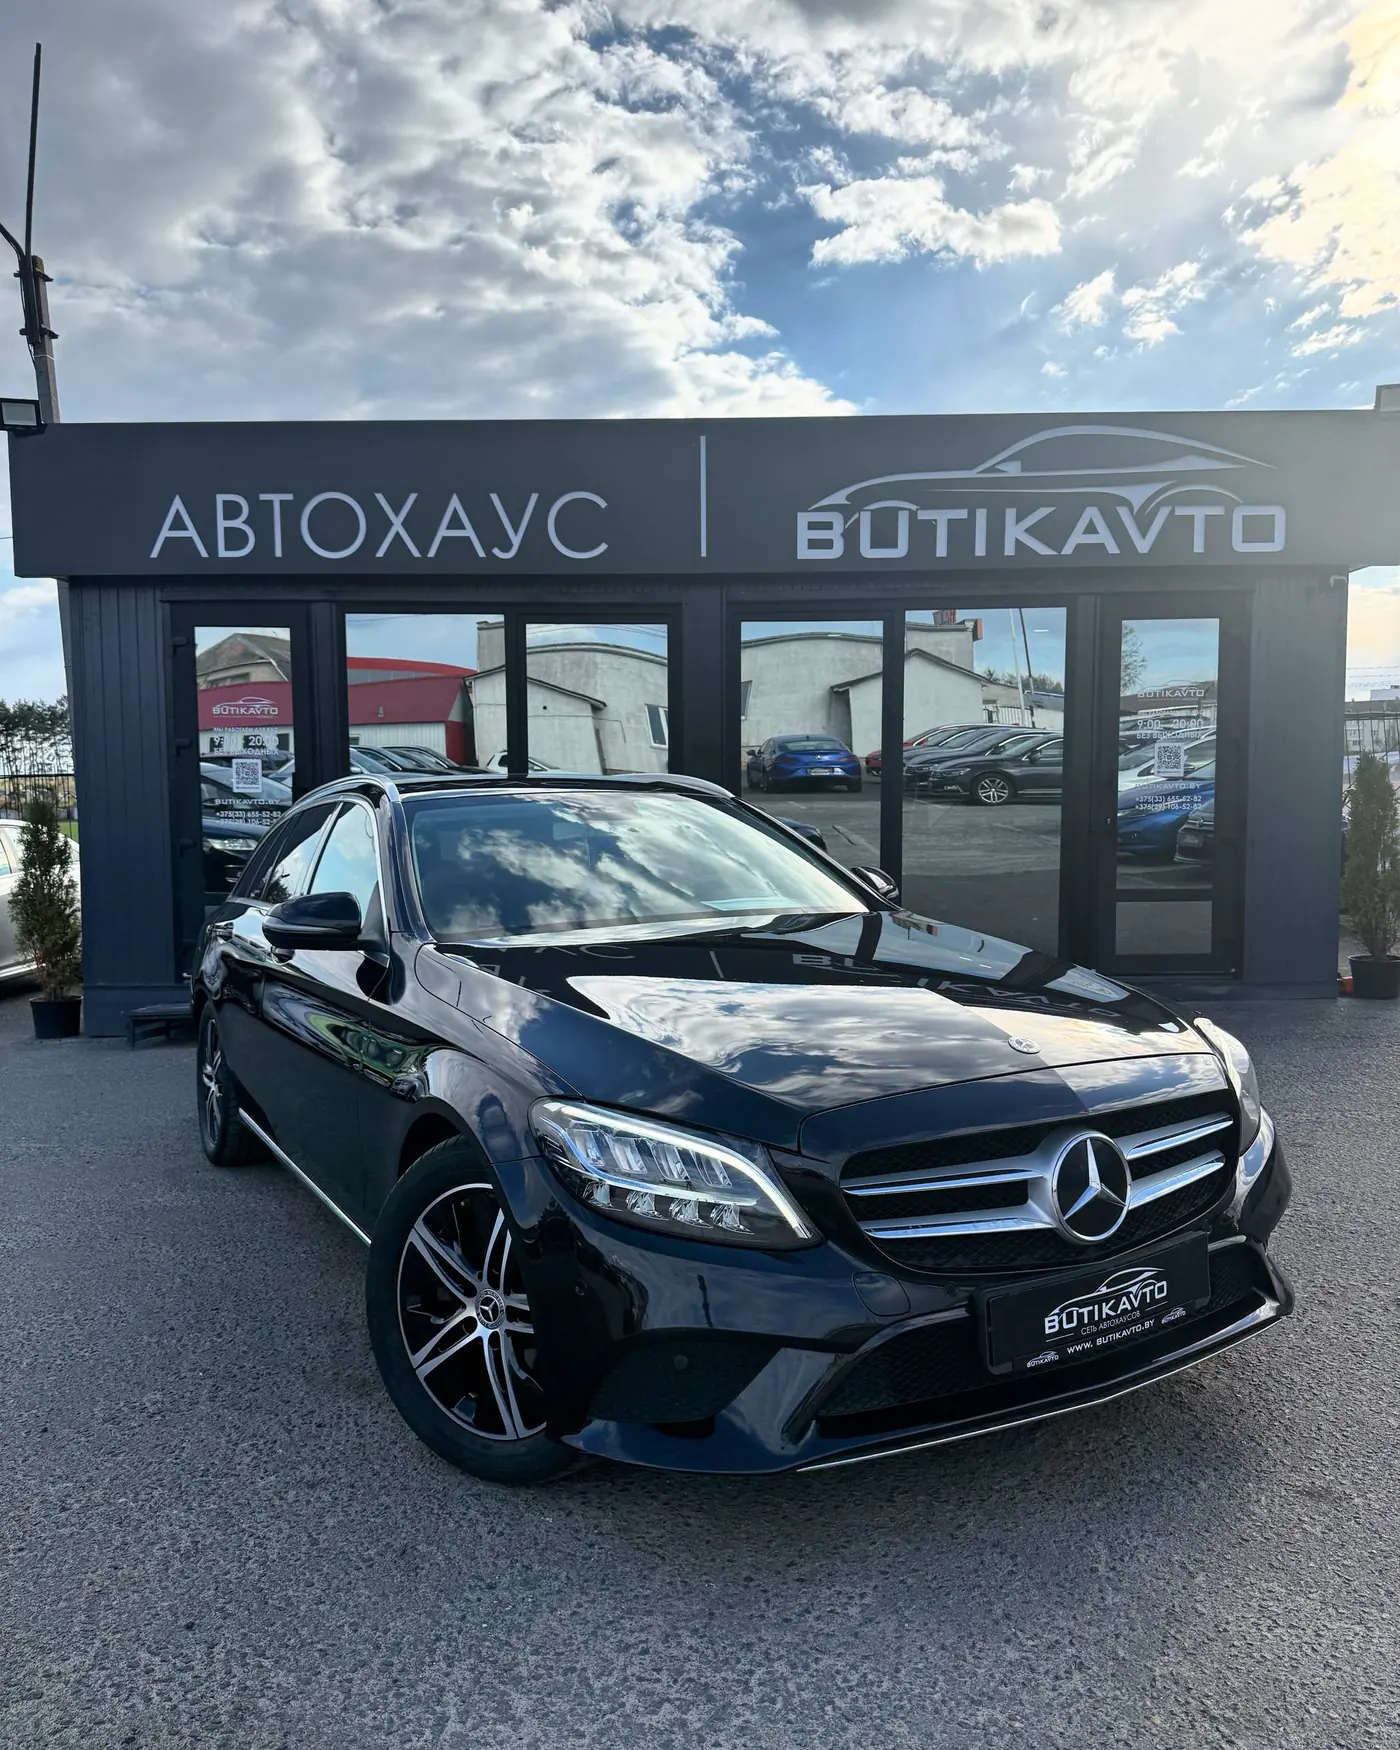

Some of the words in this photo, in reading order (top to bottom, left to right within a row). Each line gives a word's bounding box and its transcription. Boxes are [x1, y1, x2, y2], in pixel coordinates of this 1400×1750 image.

[150, 491, 609, 560] АВТОХАУС
[797, 504, 1287, 560] BUTIKAVTO
[1137, 719, 1160, 729] 9:00
[1135, 795, 1166, 804] +375(33)
[215, 810, 246, 819] +375(33)
[1045, 1281, 1167, 1334] BUTIKAVTO
[1080, 1324, 1098, 1336] СЕТЬ
[1099, 1309, 1141, 1331] АВТОХАУСОВ
[1067, 1340, 1094, 1355] WWW.
[1096, 1318, 1155, 1346] BUTIKAVTO.BY
[1026, 1354, 1060, 1368] BUTIKAVTO
